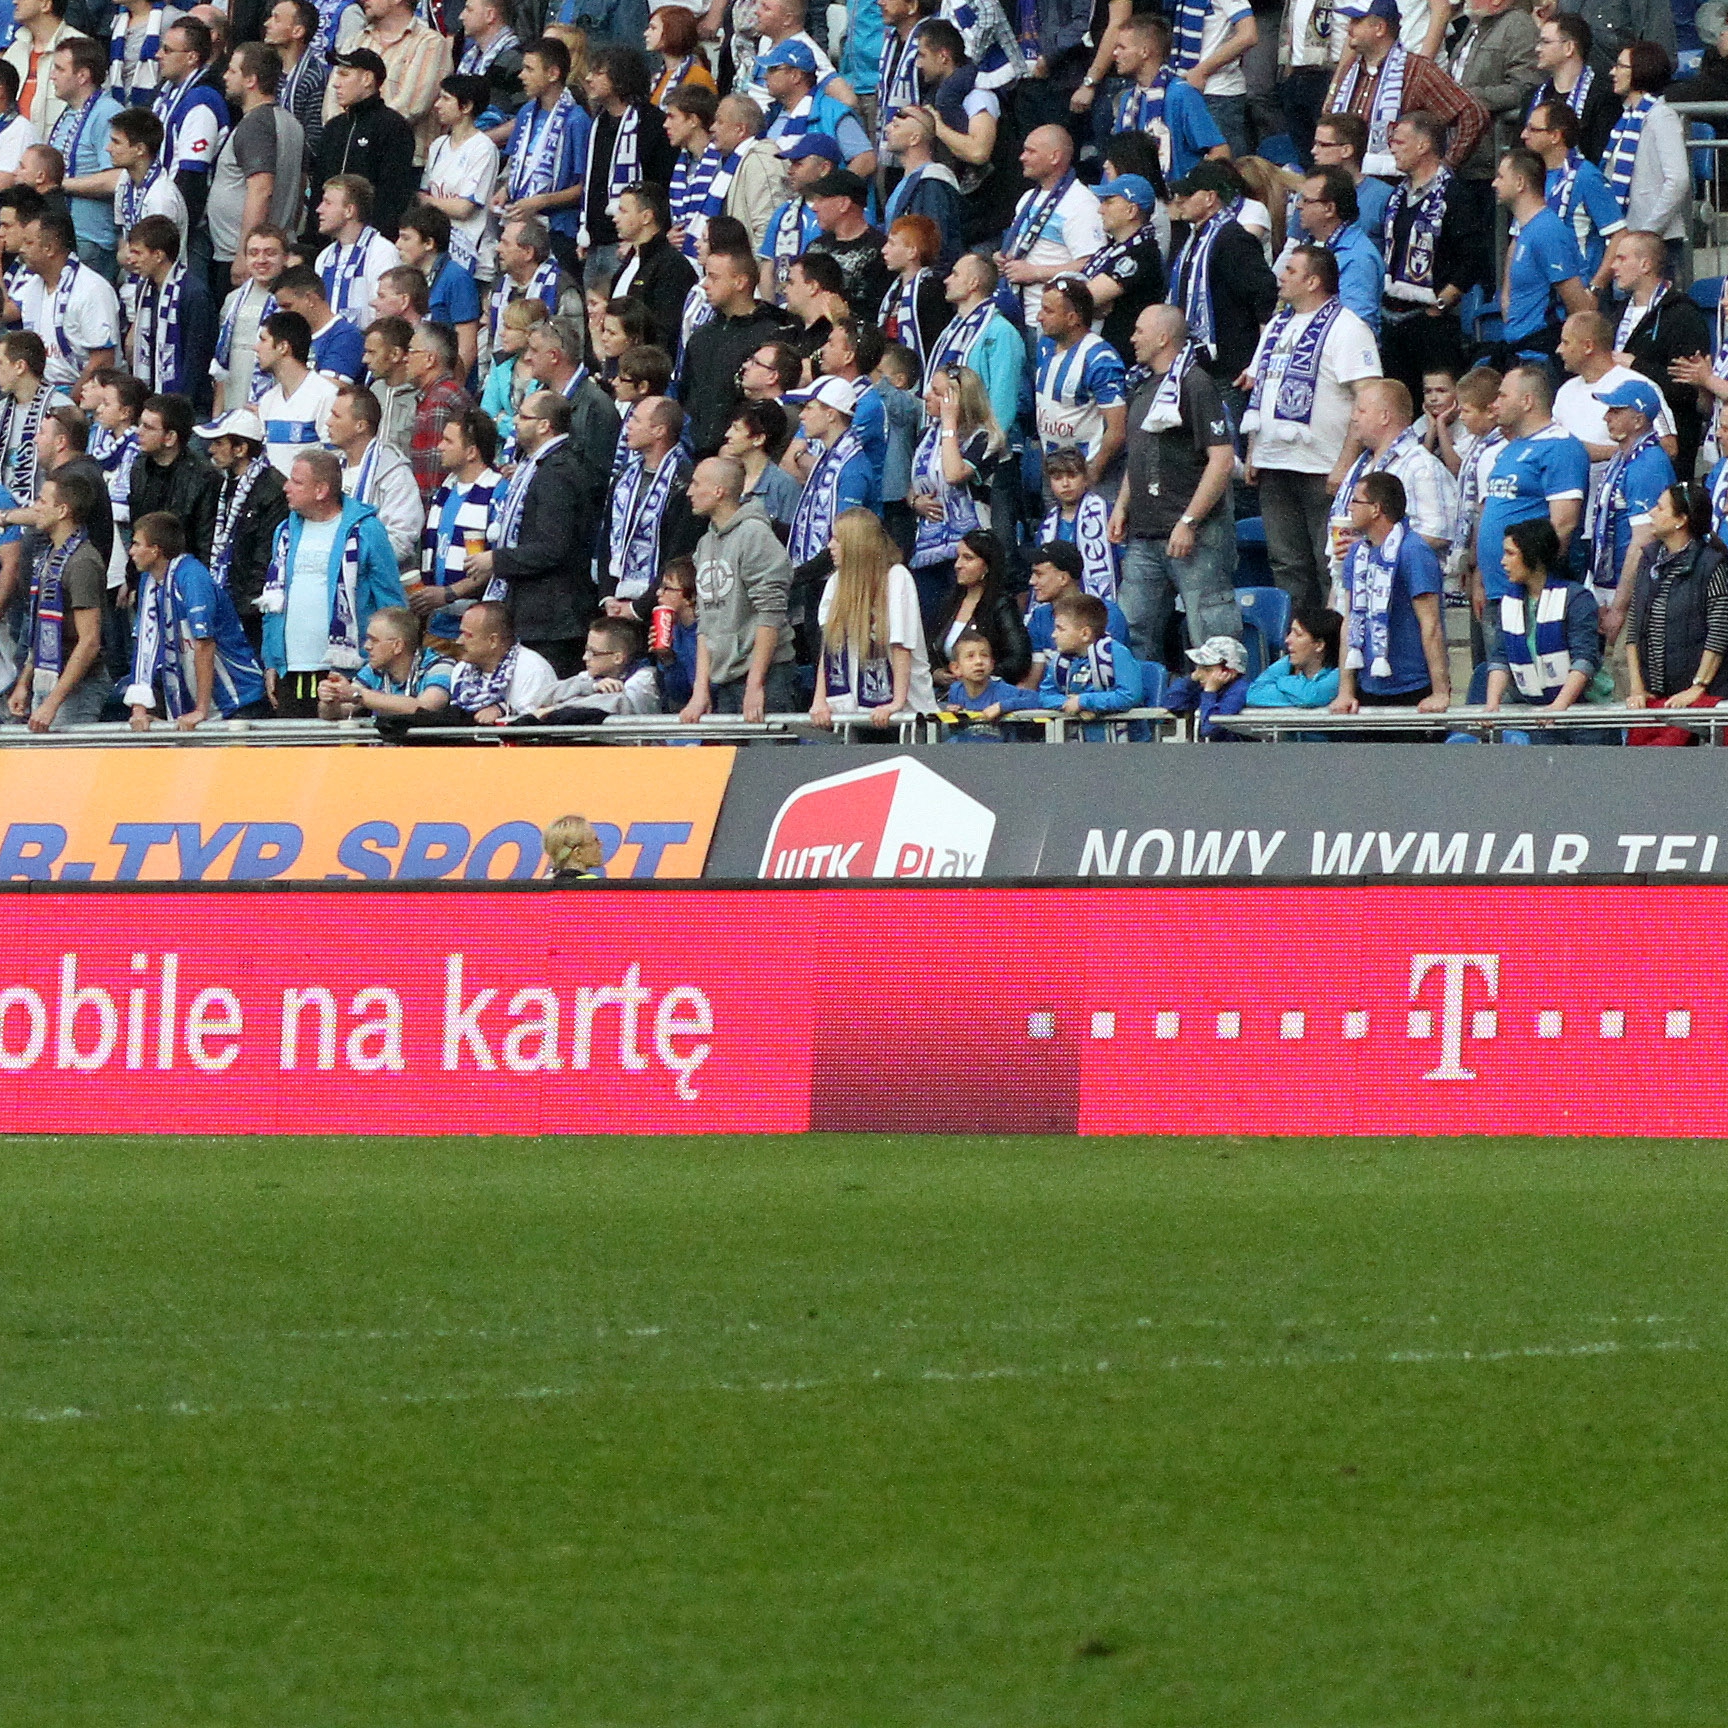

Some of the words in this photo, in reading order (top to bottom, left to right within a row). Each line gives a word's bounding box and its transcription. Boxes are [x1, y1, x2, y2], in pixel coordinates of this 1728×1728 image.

[1078, 829, 1287, 876] NOWY
[1310, 831, 1590, 875] WYMIAR
[280, 986, 405, 1071] na
[442, 954, 715, 1102] kartę
